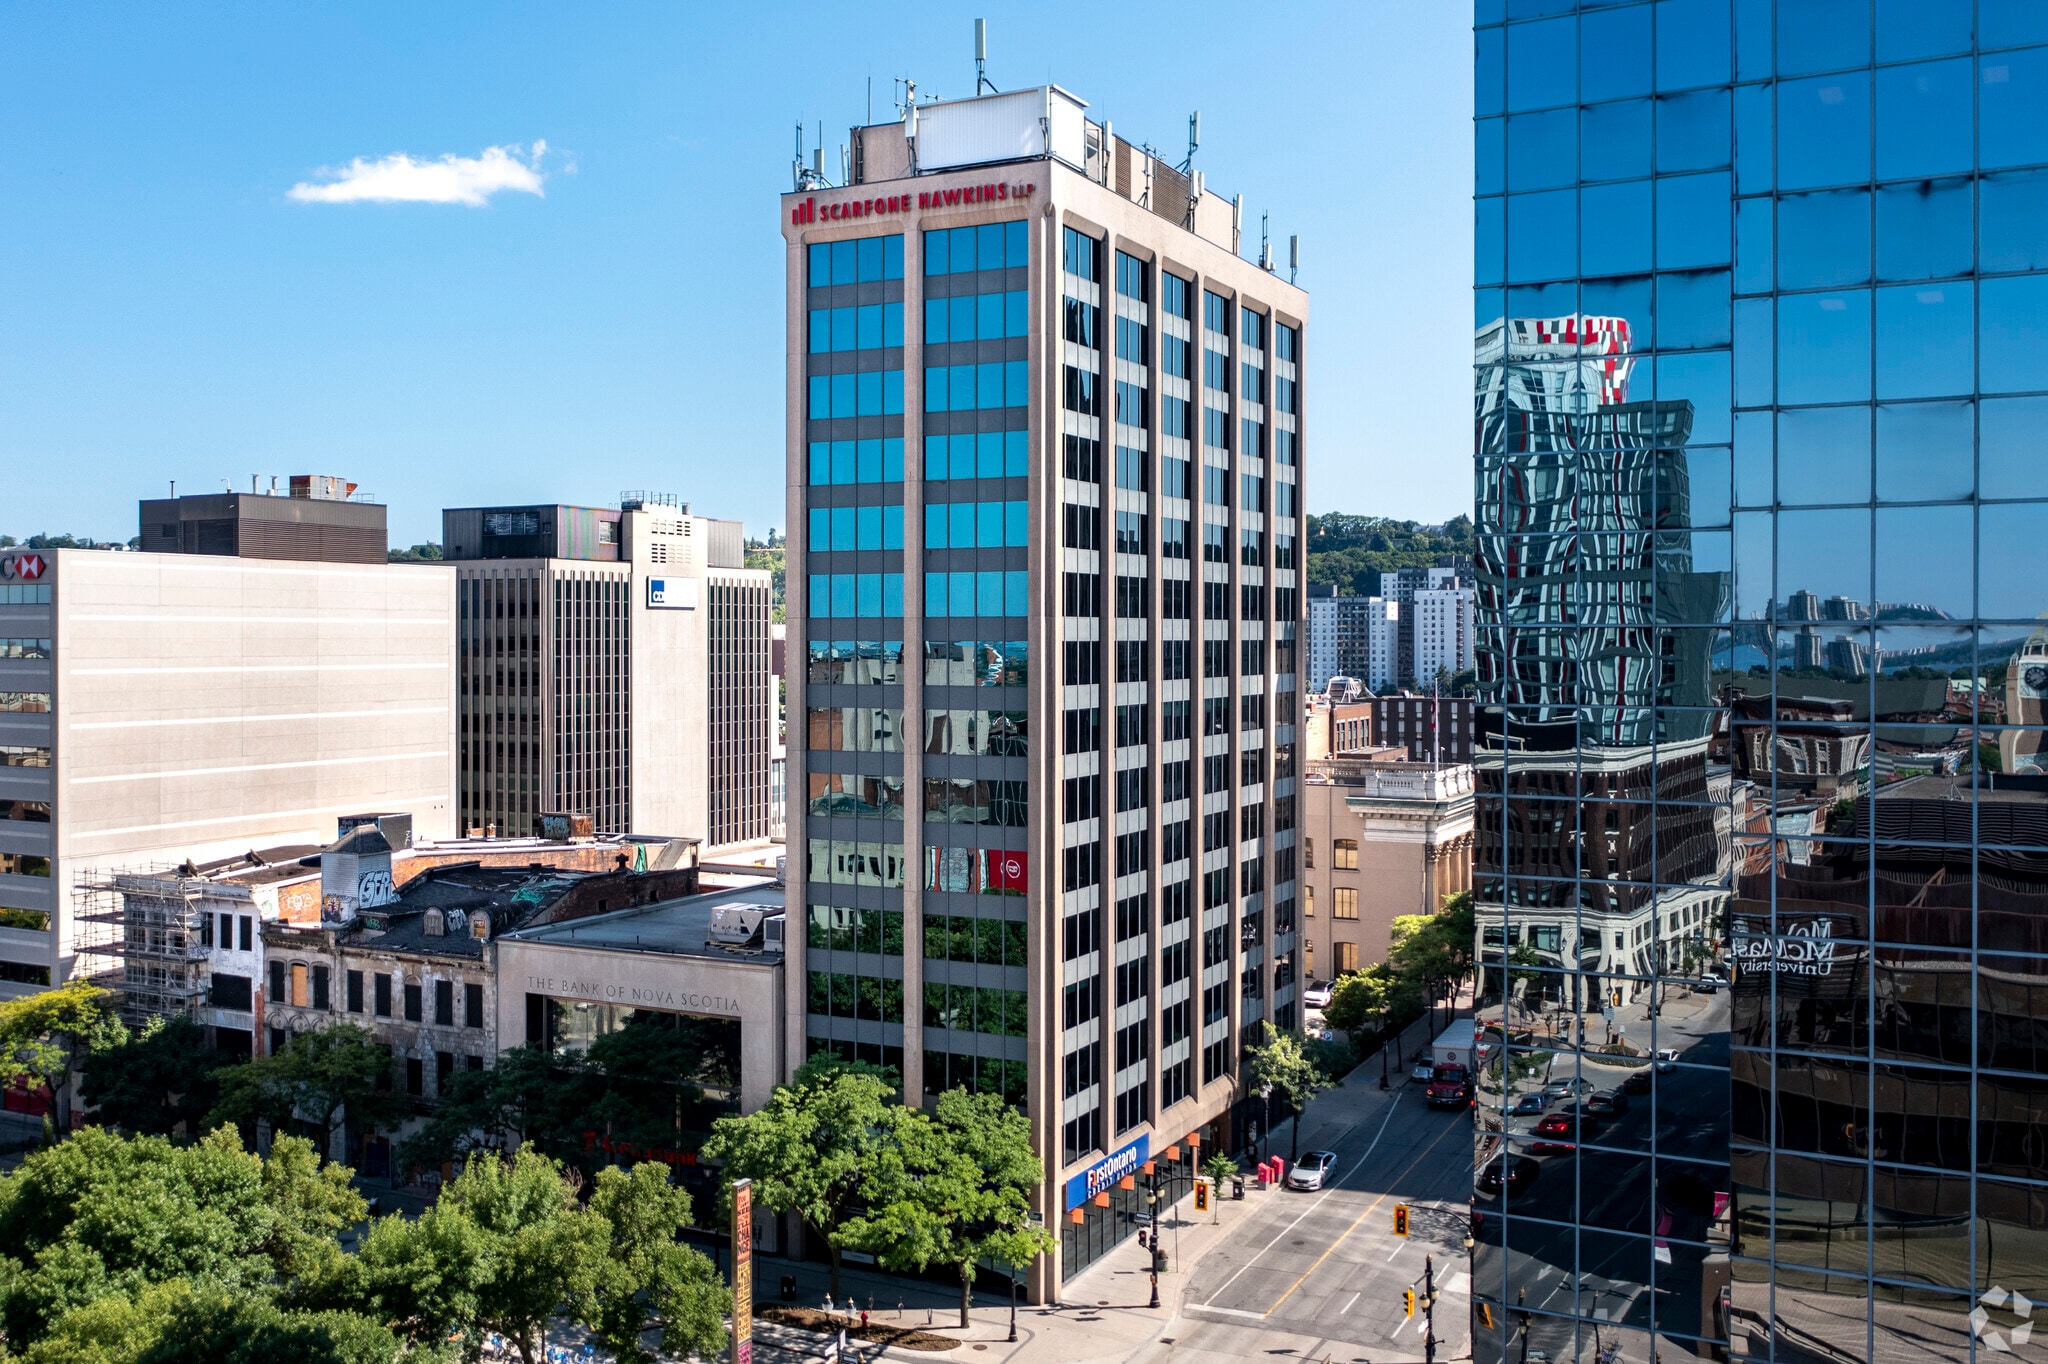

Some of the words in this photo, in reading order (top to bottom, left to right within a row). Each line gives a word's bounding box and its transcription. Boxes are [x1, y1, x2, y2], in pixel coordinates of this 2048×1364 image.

[819, 193, 911, 221] SCARFONE
[918, 183, 1008, 209] HAWKINS
[1011, 183, 1035, 199] LLP
[528, 976, 554, 991] THE
[562, 980, 599, 997] BANK
[605, 985, 625, 999] OF
[632, 988, 674, 1005] NOVA
[681, 993, 740, 1012] SCOTIA
